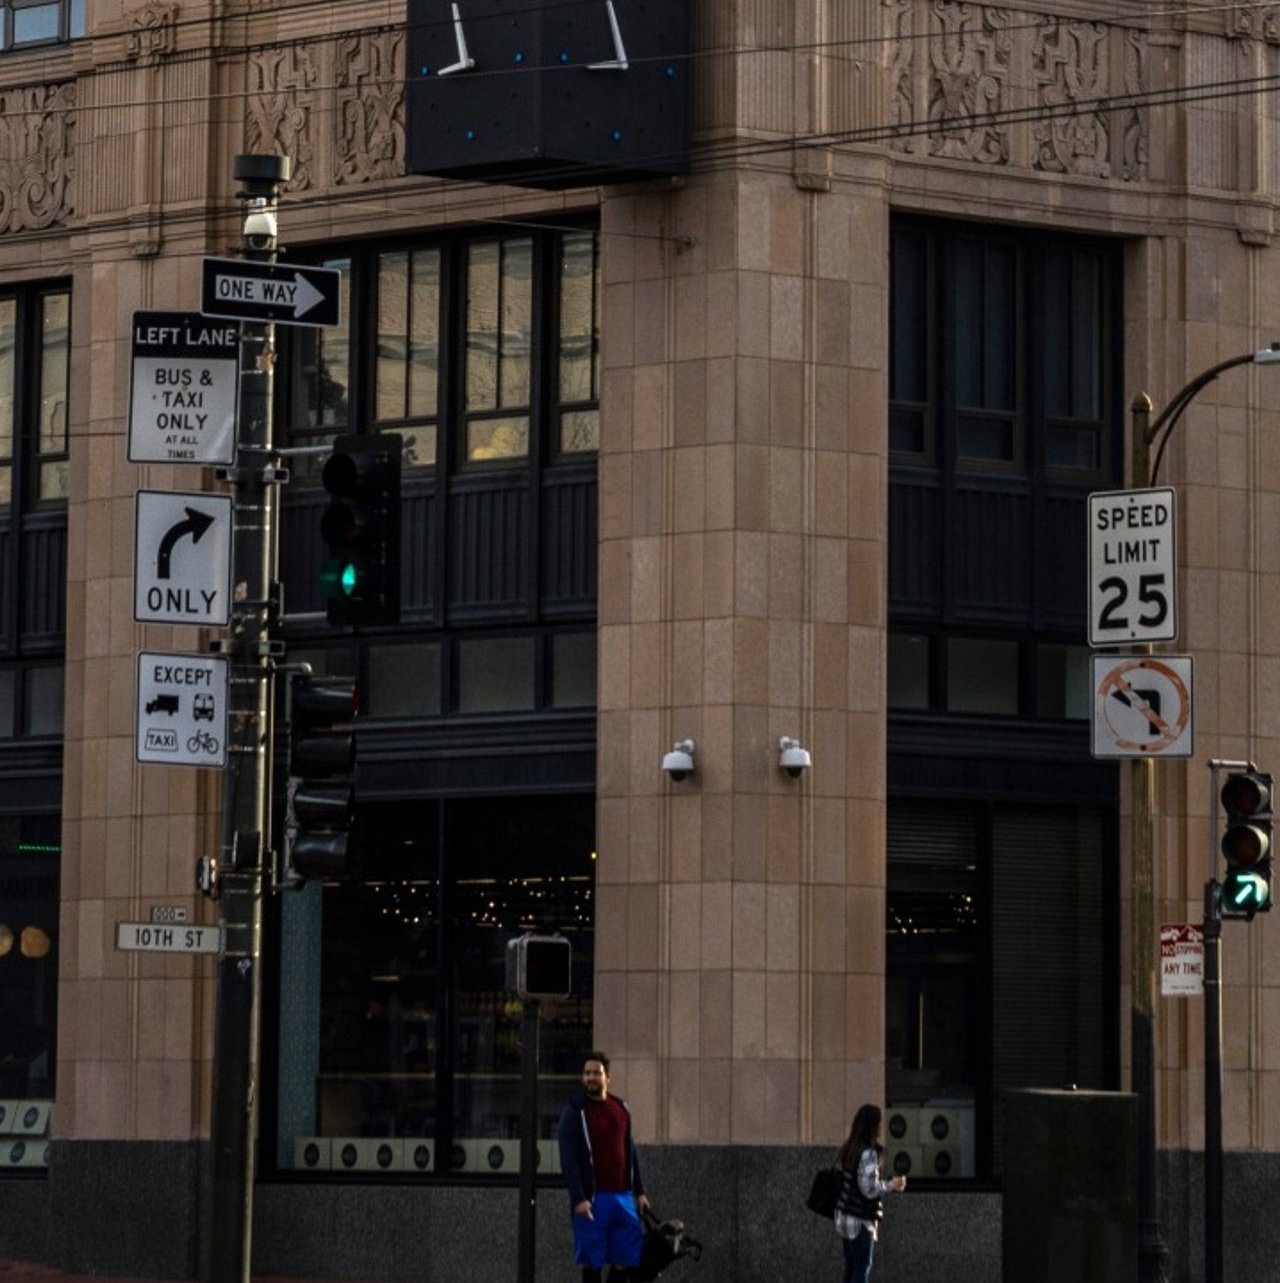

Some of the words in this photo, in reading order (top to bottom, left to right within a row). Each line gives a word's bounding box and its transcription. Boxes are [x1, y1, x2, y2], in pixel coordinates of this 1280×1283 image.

[219, 278, 255, 300] ONE
[261, 282, 298, 304] WAY
[135, 326, 181, 345] LEFT
[185, 327, 237, 347] LANE
[154, 368, 193, 386] BUS
[199, 369, 213, 387] &
[162, 390, 204, 408] TAXI
[156, 412, 209, 430] ONLY
[165, 435, 178, 445] AT
[180, 435, 199, 445] ALL
[167, 449, 196, 460] TIMES
[1096, 504, 1168, 531] SPEED
[1103, 539, 1160, 565] LIMIT
[147, 587, 217, 615] ONLY
[1098, 573, 1168, 630] 25
[154, 665, 213, 686] EXCEPT
[149, 734, 175, 747] TAXI
[135, 928, 173, 947] 10TH
[185, 929, 204, 948] ST
[1163, 962, 1180, 974] ANY
